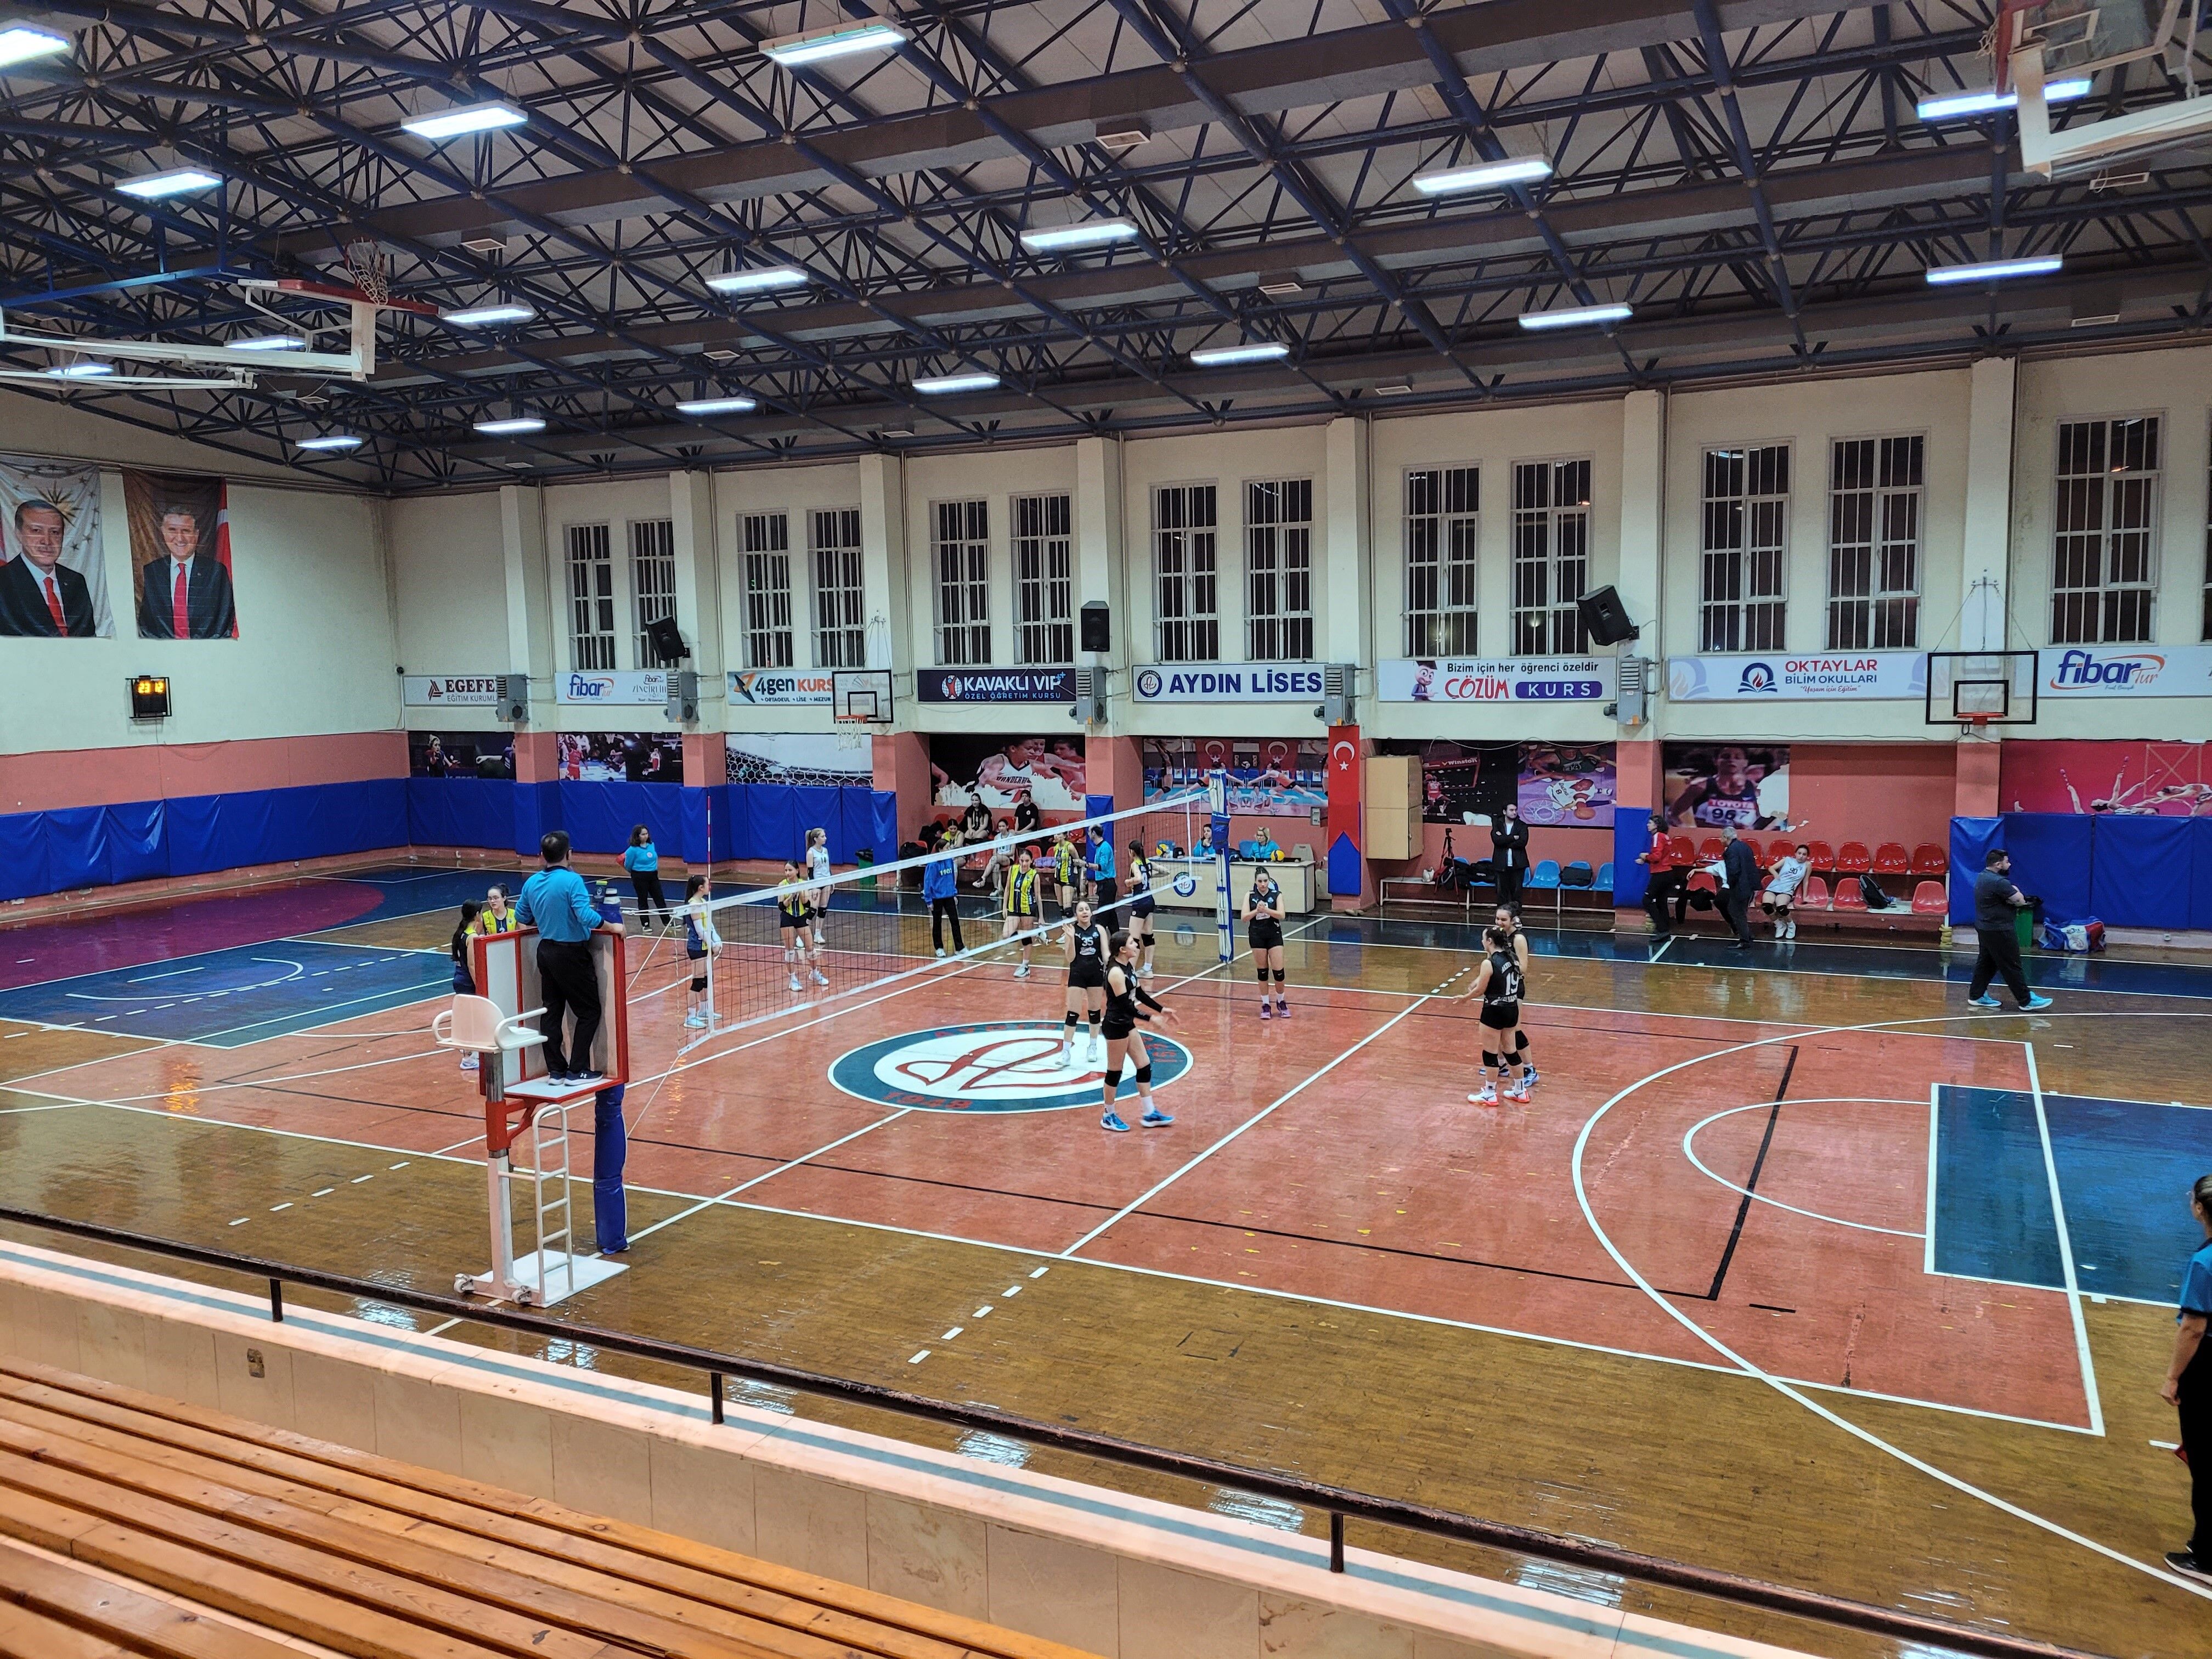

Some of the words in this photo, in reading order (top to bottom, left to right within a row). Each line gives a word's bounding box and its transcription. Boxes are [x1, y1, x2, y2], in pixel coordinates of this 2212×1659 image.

[1447, 663, 1474, 672] Bizim
[1477, 663, 1495, 675] için
[1498, 663, 1515, 672] her
[1521, 662, 1559, 674] öğrenci
[1562, 662, 1599, 672] özeldir
[1785, 659, 1877, 673] OKTAYLAR
[2058, 650, 2141, 684] fibar
[2132, 667, 2159, 684] Tur
[445, 679, 496, 692] EGEFE
[569, 674, 605, 696] fibar
[964, 675, 1029, 691] KAVAKLI
[1169, 673, 1241, 693] AYDIN
[1252, 669, 1323, 693] LİSES
[1785, 673, 1816, 684] BİLİM
[1818, 674, 1877, 684] OKULLARI
[755, 677, 795, 695] 4gen
[797, 679, 833, 692] KURS
[1444, 675, 1510, 699] ÇÖZÜM
[1528, 683, 1591, 696] KURS
[990, 691, 1028, 699] ÖĞRETİM
[1712, 808, 1750, 820] 967
[1081, 936, 1094, 946] 35
